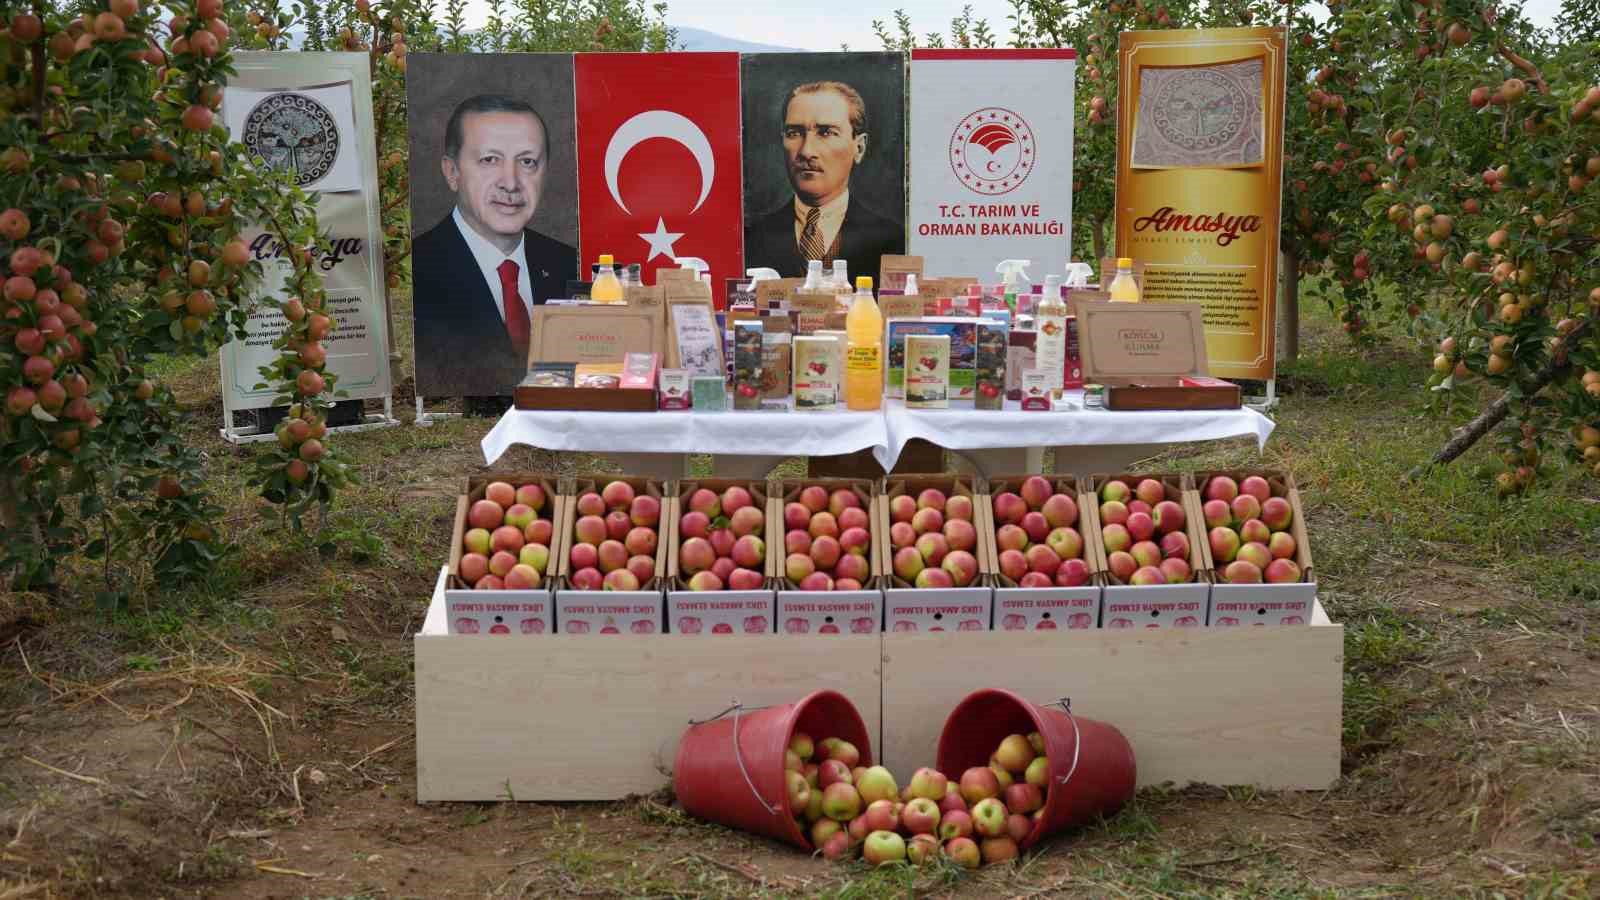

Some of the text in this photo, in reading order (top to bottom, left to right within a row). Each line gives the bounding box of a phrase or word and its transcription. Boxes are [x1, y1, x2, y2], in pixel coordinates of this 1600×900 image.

[938, 204, 1040, 218] T.C. TARIM VE
[918, 220, 1064, 236] ORMAN BAKANLIĞI
[1133, 206, 1261, 247] Amasya
[486, 604, 520, 612] AMASYA
[710, 602, 742, 610] AMASYA
[818, 604, 850, 612] AMASYA
[1036, 600, 1070, 608] AMASYA
[1142, 604, 1176, 612] AMASYA
[1250, 602, 1282, 611] AMASYA
[598, 606, 630, 614] AMASYA
[926, 606, 960, 614] AMASYA
